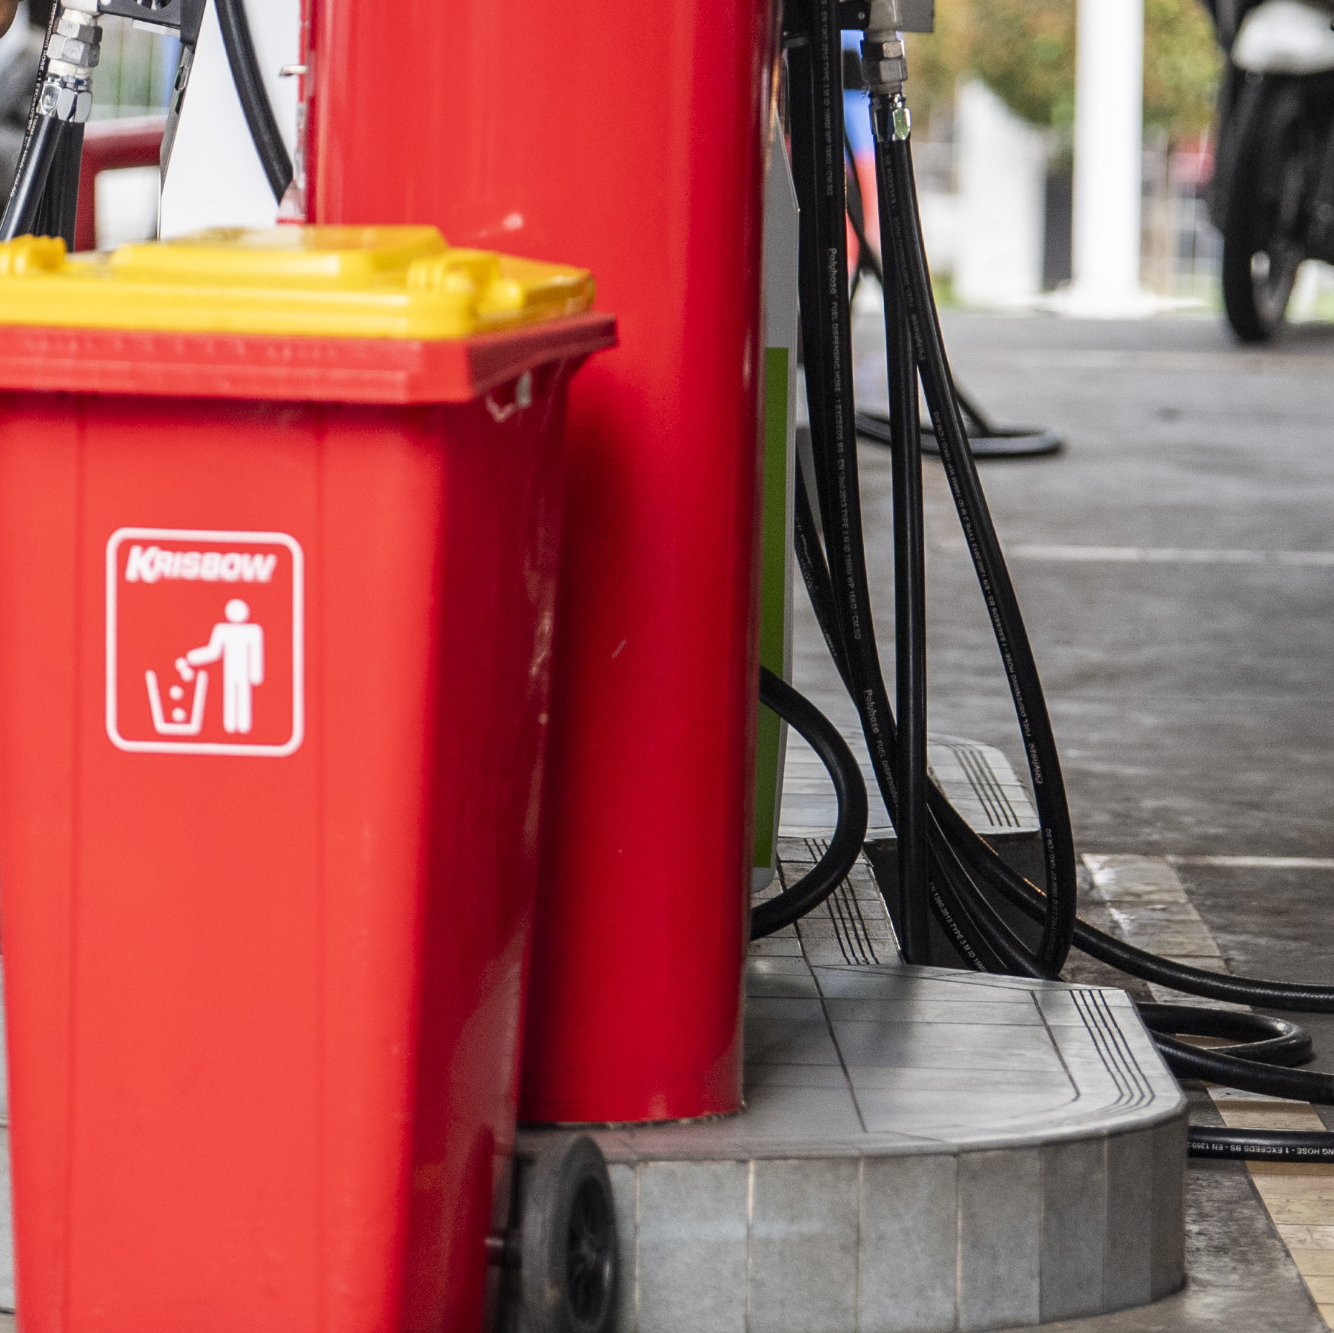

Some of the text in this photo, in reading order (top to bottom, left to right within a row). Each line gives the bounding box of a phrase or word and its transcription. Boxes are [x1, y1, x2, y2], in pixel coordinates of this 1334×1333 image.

[964, 522, 975, 540] TYPE
[982, 580, 990, 590] EN
[991, 608, 1005, 641] EXCEEDS
[1005, 652, 1015, 672] HOSE
[1010, 674, 1026, 718] DISPENSING
[865, 689, 879, 734] Polyhose
[877, 740, 886, 760] FUEL
[1022, 718, 1031, 737] FUEL
[1028, 742, 1043, 784] Polyhose
[949, 922, 963, 940] TYPE
[1212, 1143, 1223, 1151] EN
[1230, 1144, 1242, 1152] BS
[1243, 1145, 1283, 1153] EXCEEDS
[1297, 1147, 1320, 1155] HOSE
